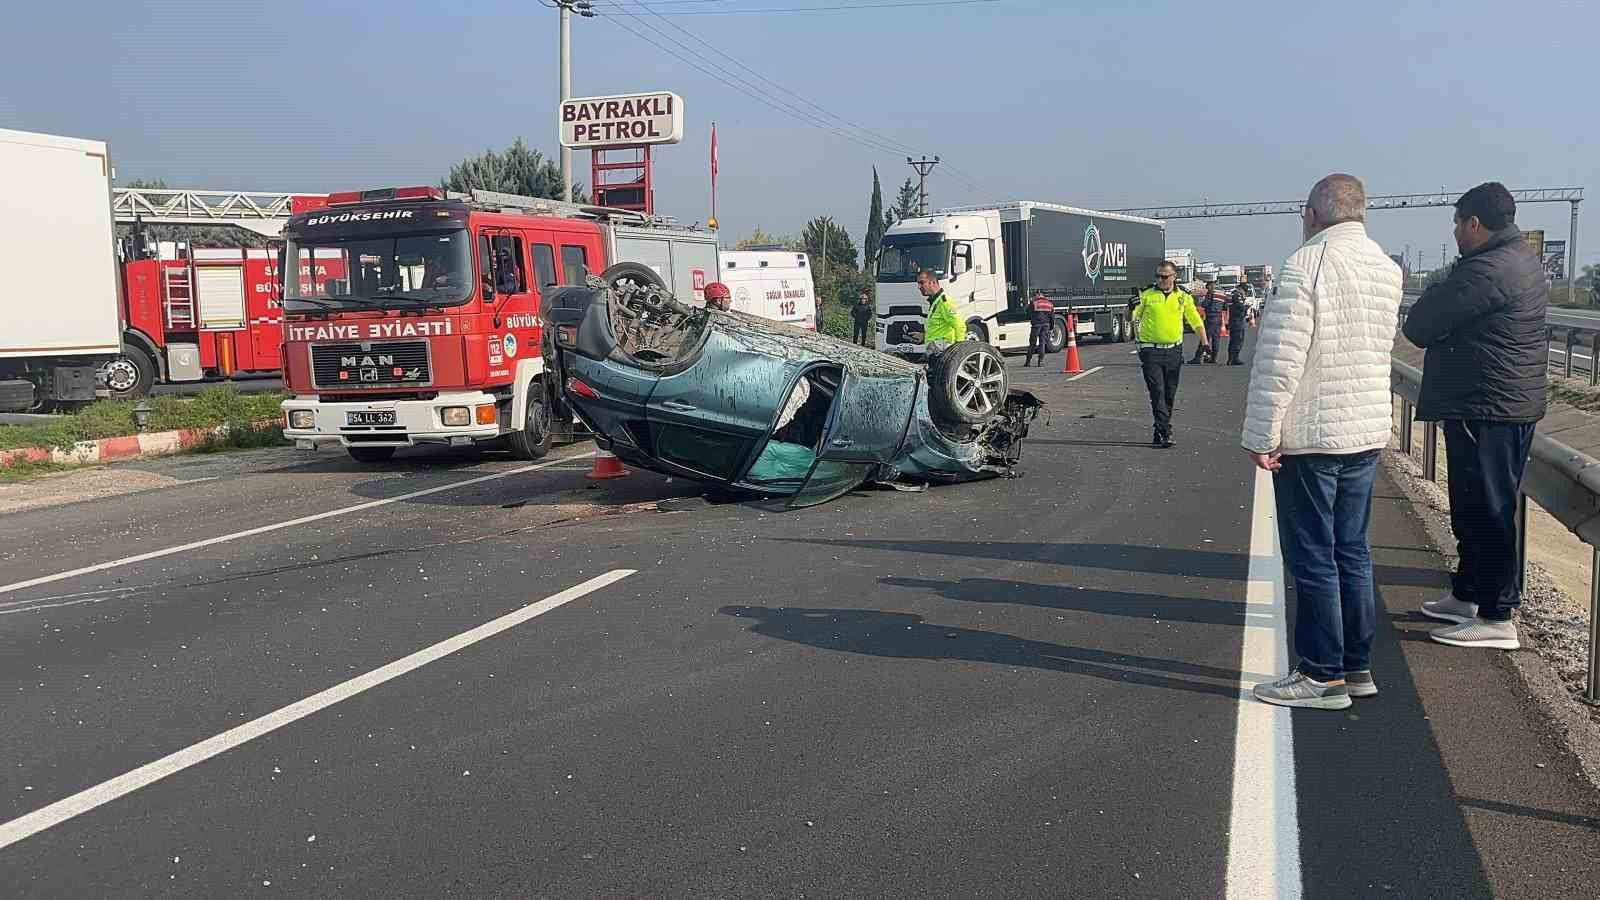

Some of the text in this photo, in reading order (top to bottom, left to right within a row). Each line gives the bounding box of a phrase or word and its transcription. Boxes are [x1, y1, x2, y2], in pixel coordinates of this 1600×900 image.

[563, 97, 672, 121] BAYRAKLI
[574, 120, 660, 141] PETROL
[1104, 242, 1127, 267] AVCI
[780, 301, 796, 316] 112
[289, 323, 360, 341] İTFAİYE
[341, 355, 394, 367] MAN
[353, 413, 363, 423] 54
[378, 413, 393, 422] 362
